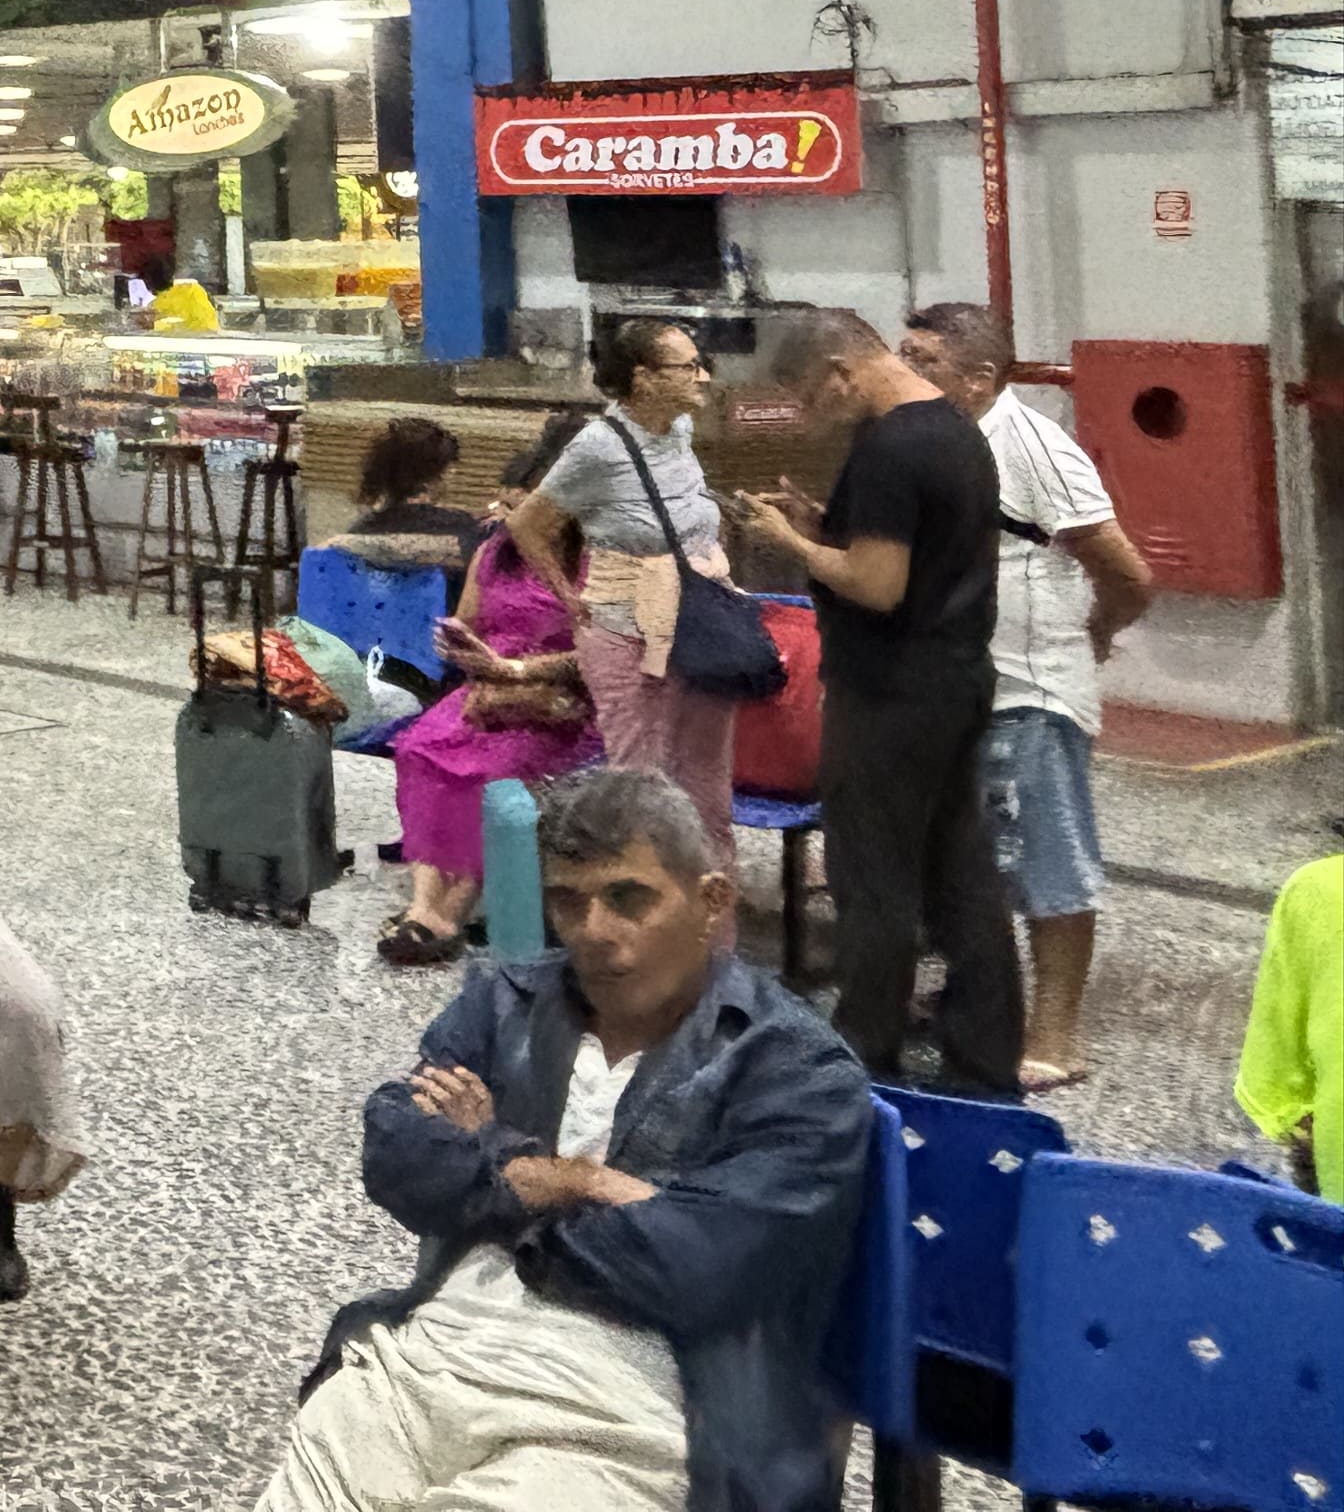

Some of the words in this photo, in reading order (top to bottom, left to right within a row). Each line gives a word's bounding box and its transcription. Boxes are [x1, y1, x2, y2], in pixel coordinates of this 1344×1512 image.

[127, 85, 243, 139] Amazon
[524, 118, 823, 174] Caramba!
[609, 172, 695, 189] SORVETES
